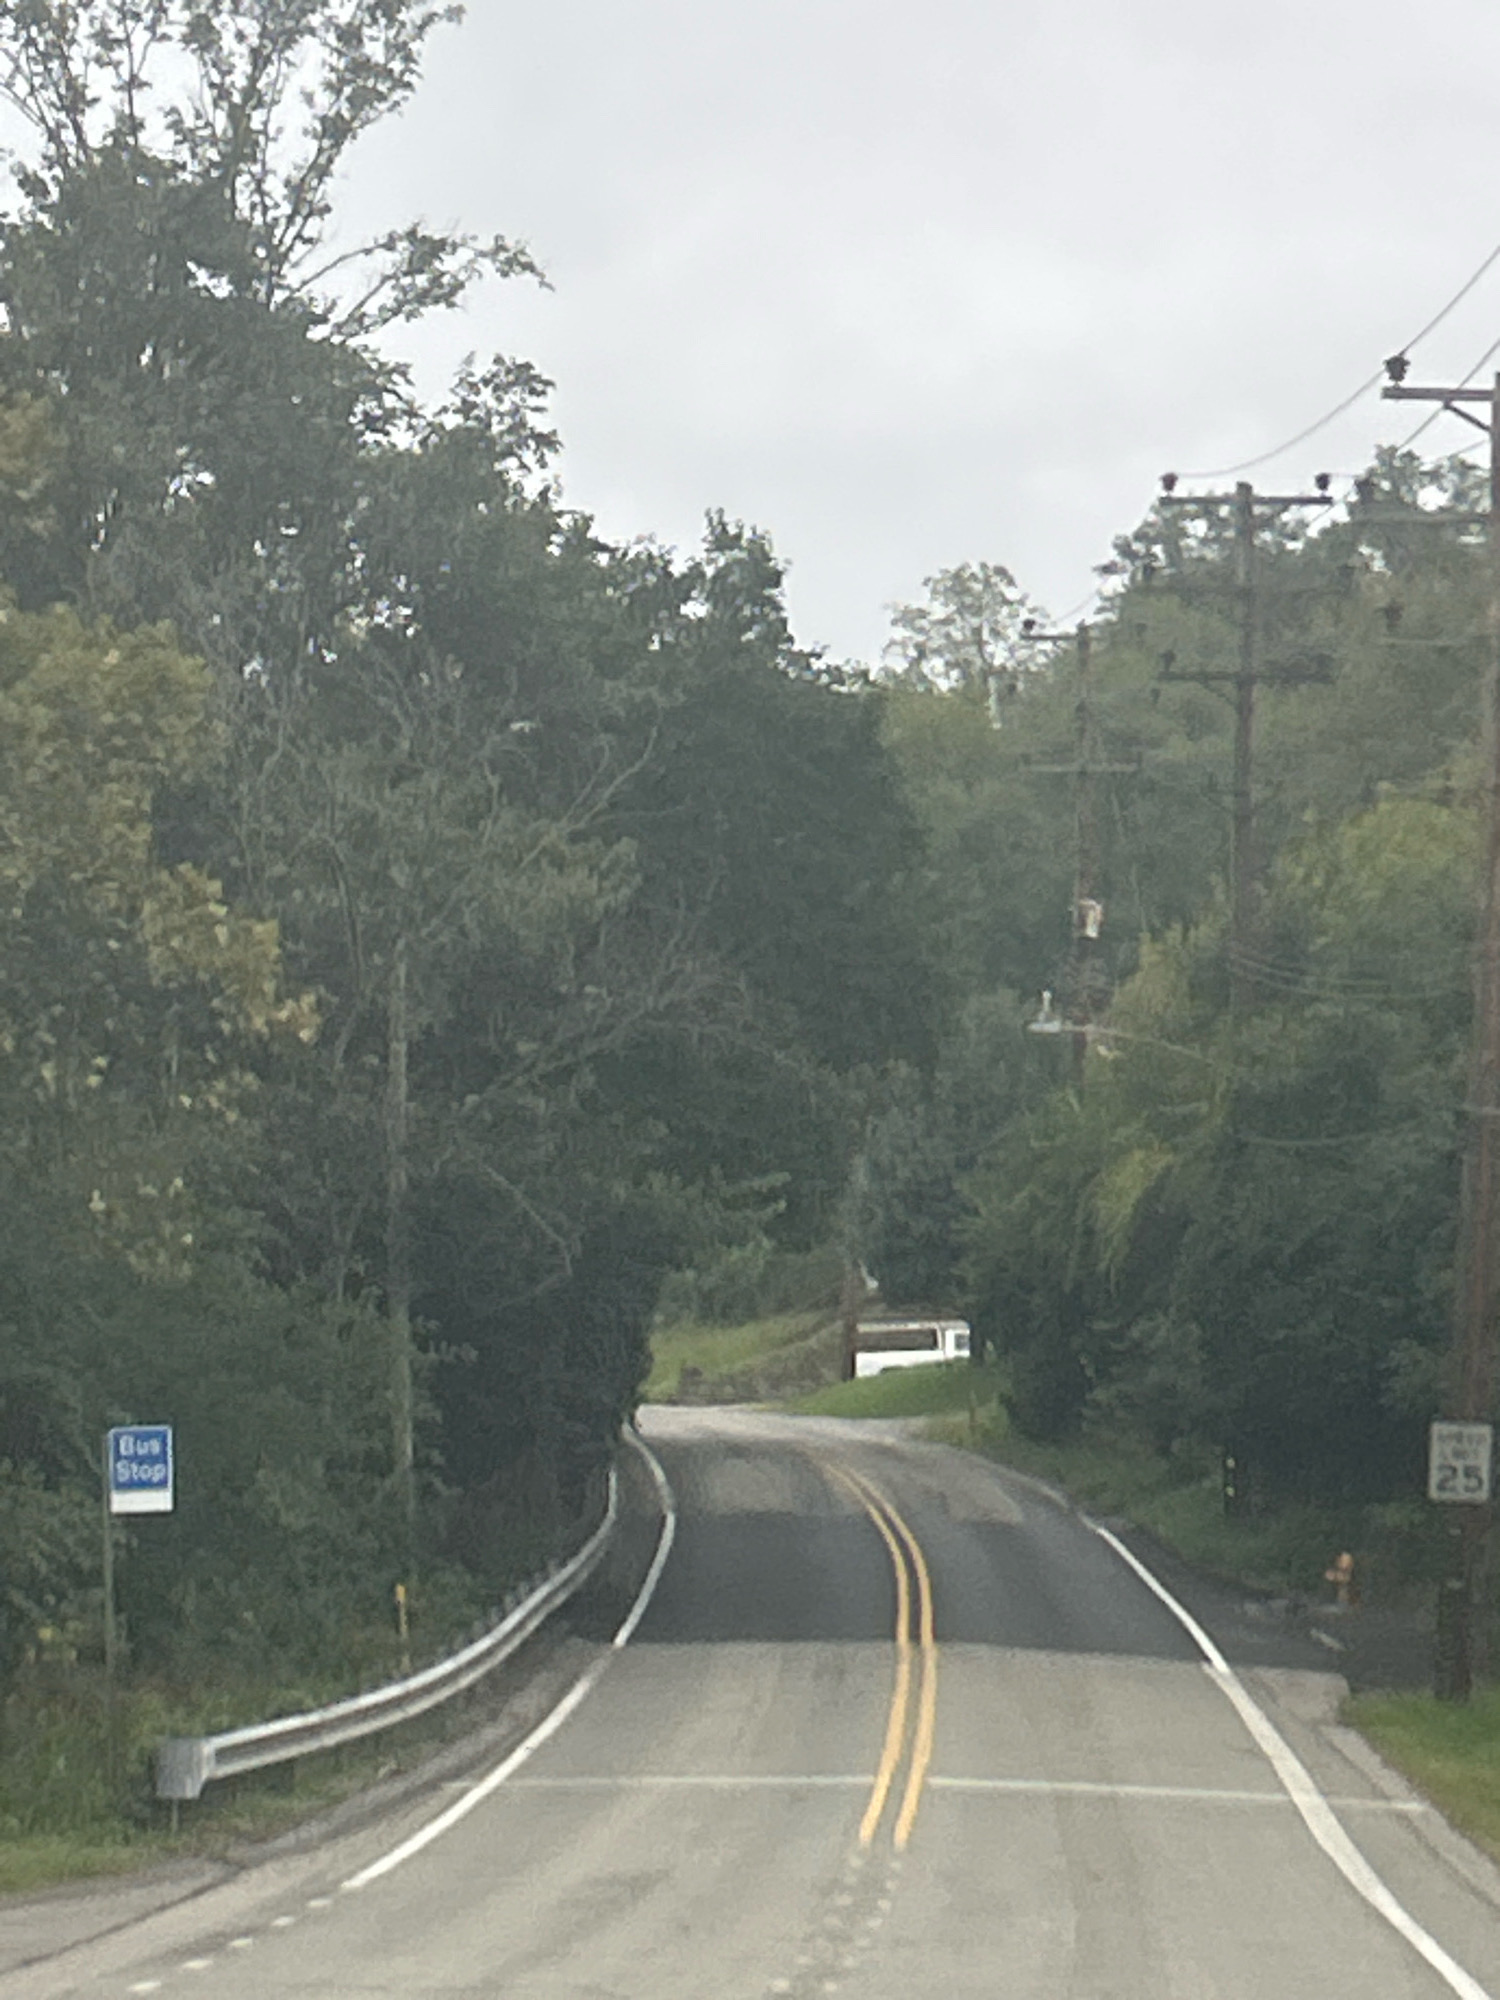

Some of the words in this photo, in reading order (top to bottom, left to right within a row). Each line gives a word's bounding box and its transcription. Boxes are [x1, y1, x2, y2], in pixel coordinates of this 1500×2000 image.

[119, 1435, 160, 1456] Bus
[116, 1459, 166, 1483] Stop
[1436, 1464, 1484, 1494] 25
